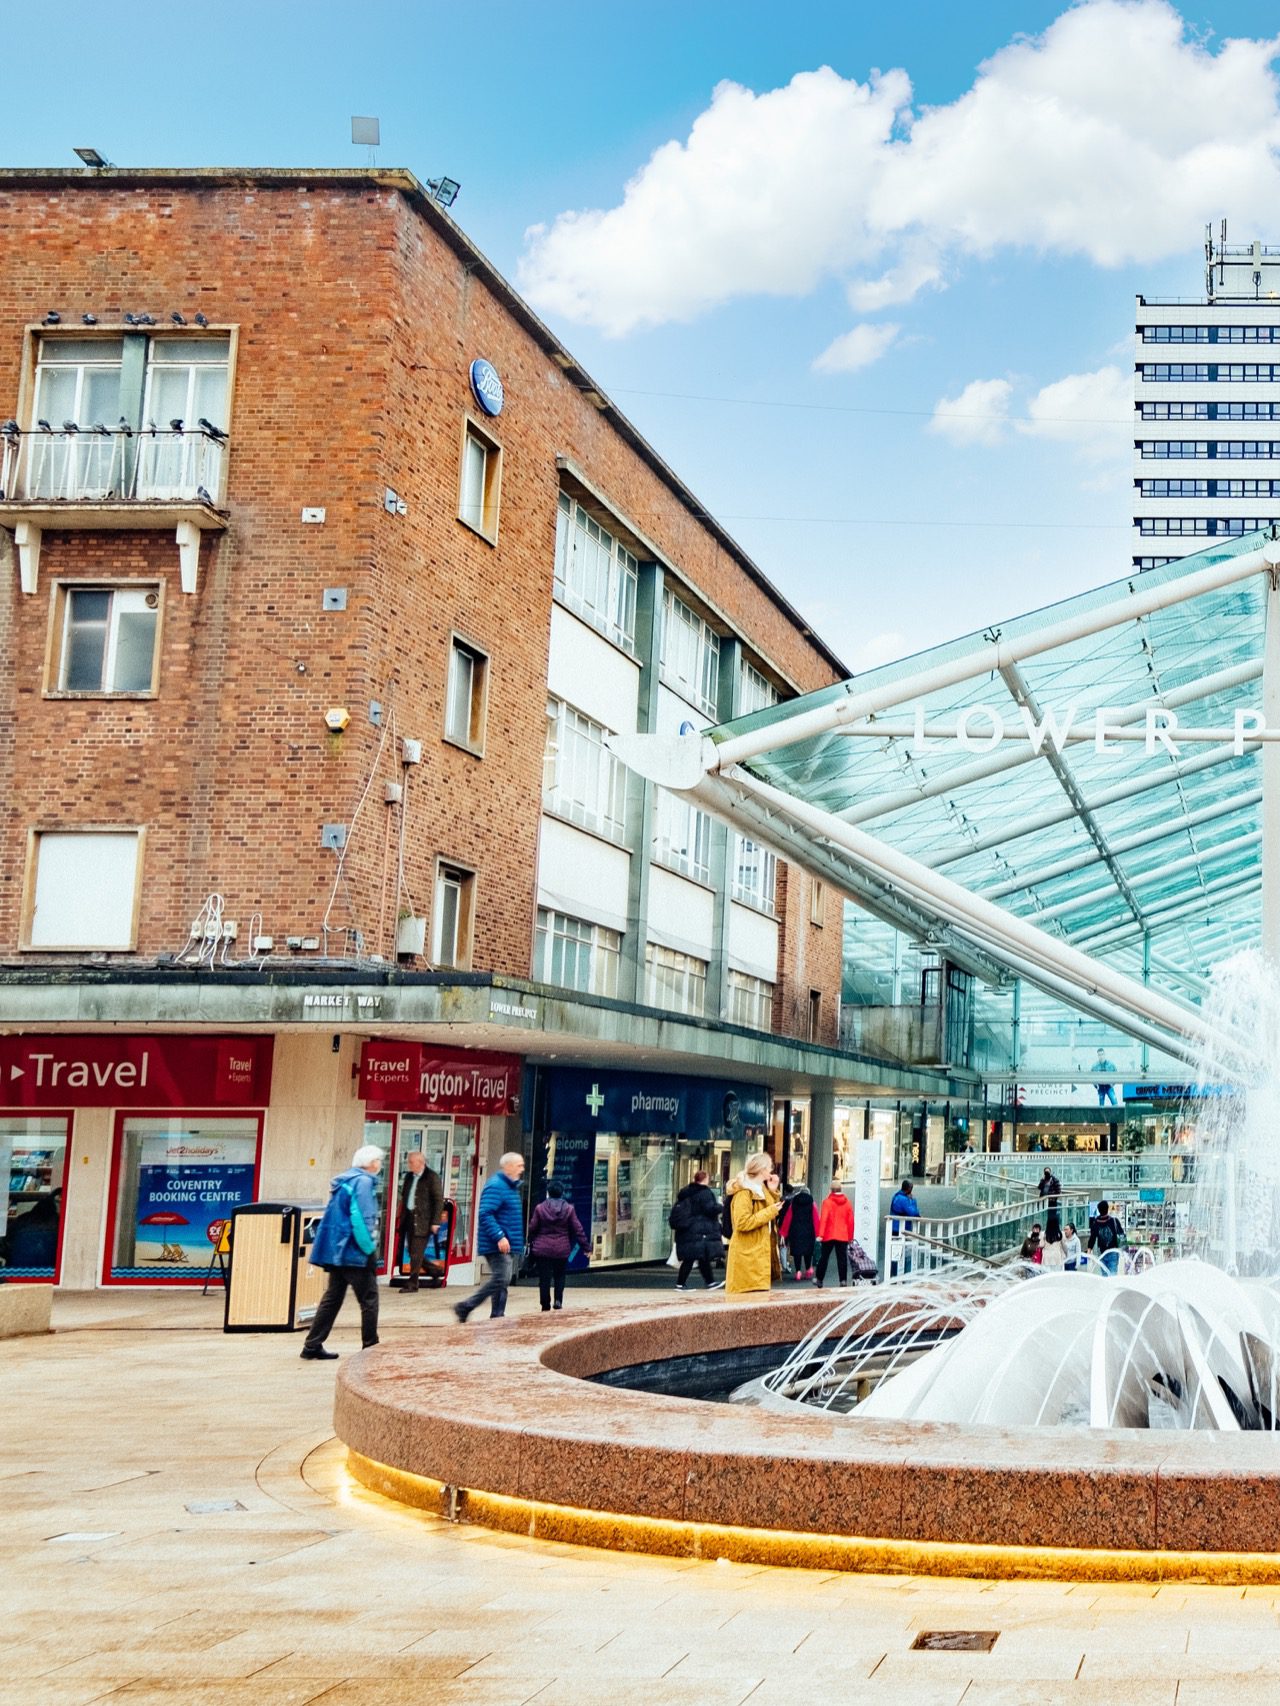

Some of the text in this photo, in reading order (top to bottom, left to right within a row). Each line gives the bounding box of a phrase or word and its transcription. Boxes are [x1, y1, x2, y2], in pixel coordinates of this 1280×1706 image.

[912, 706, 1184, 757] LOWER
[304, 995, 382, 1008] MARKET WAY
[490, 1001, 538, 1020] LOWER PRECINCT
[29, 1052, 149, 1087] Travel
[229, 1057, 252, 1071] Travel
[368, 1058, 410, 1072] Travel
[374, 1073, 409, 1083] Experts
[471, 1070, 508, 1099] Travel
[631, 1091, 680, 1115] pharmacy
[556, 1137, 589, 1150] elcome
[167, 1180, 223, 1191] COVENTRY
[149, 1191, 242, 1202] BOOKING CENTRE
